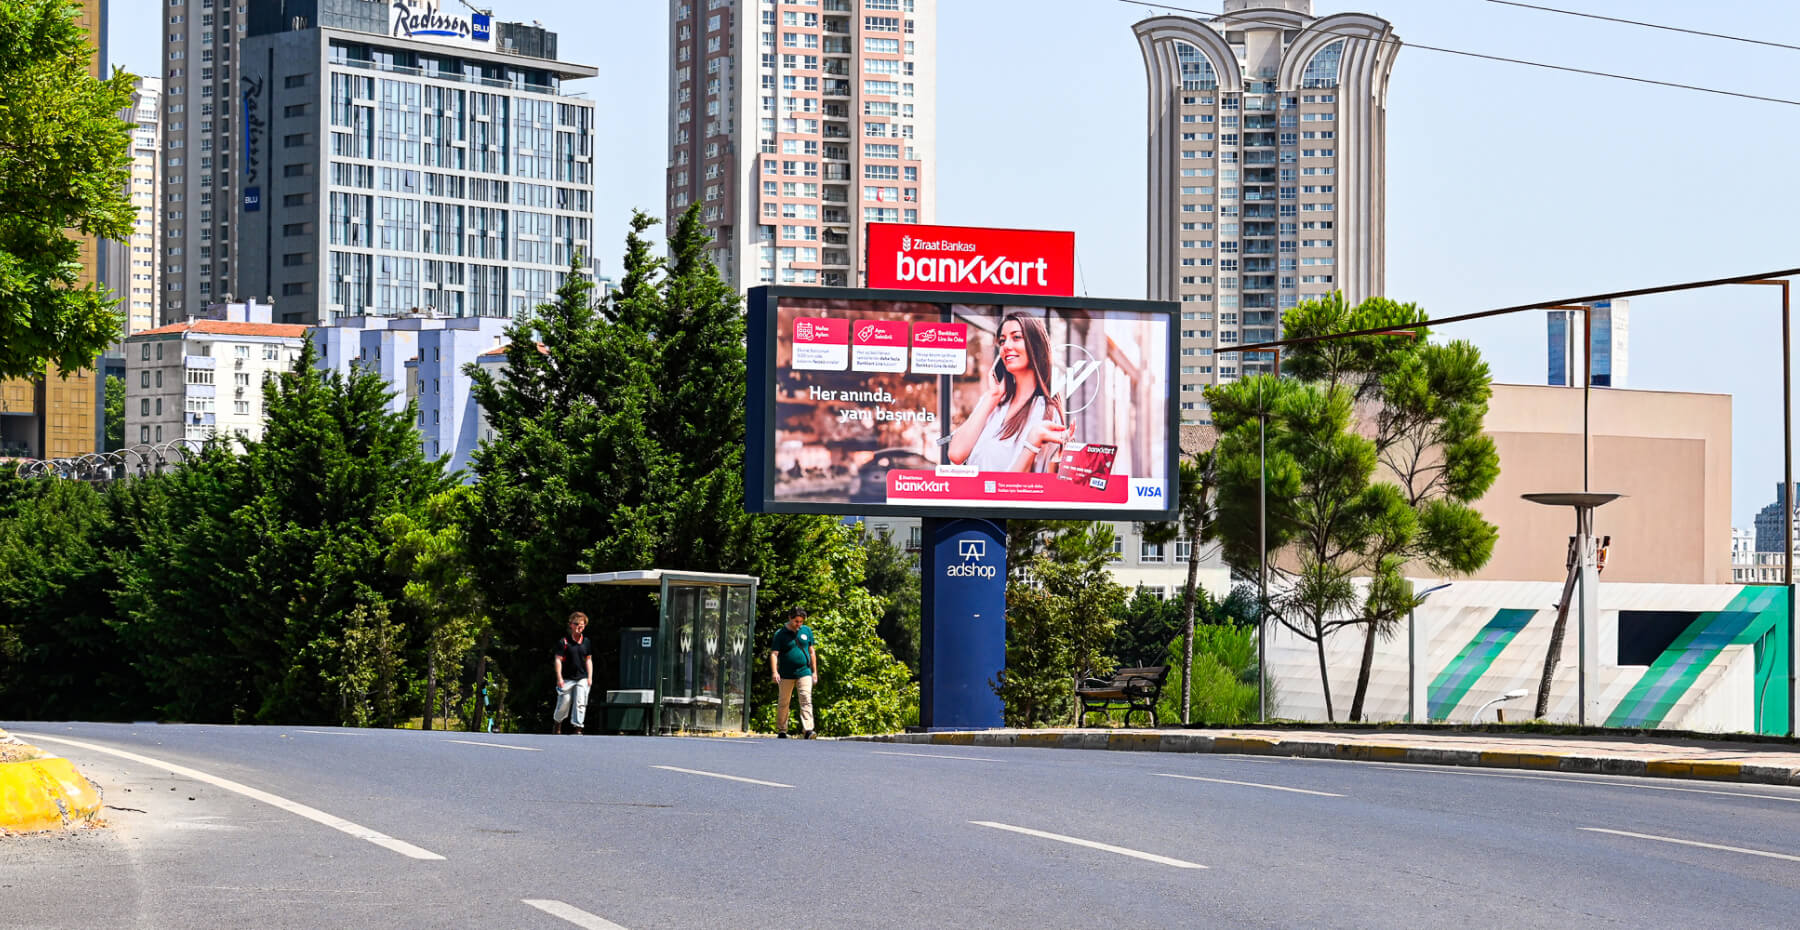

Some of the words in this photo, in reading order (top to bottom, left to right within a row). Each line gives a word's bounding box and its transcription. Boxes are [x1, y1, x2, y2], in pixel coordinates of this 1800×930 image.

[393, 1, 470, 37] Radisson
[473, 24, 489, 33] BLU
[242, 74, 264, 183] Radisson
[244, 196, 258, 204] BLU
[914, 239, 941, 251] Ziraat
[941, 240, 976, 252] Bankası
[809, 385, 837, 401] Her
[840, 387, 896, 405] anında,
[840, 408, 872, 424] yanı
[875, 405, 935, 425] başında
[1136, 486, 1162, 497] VISA
[947, 562, 996, 580] adshop
